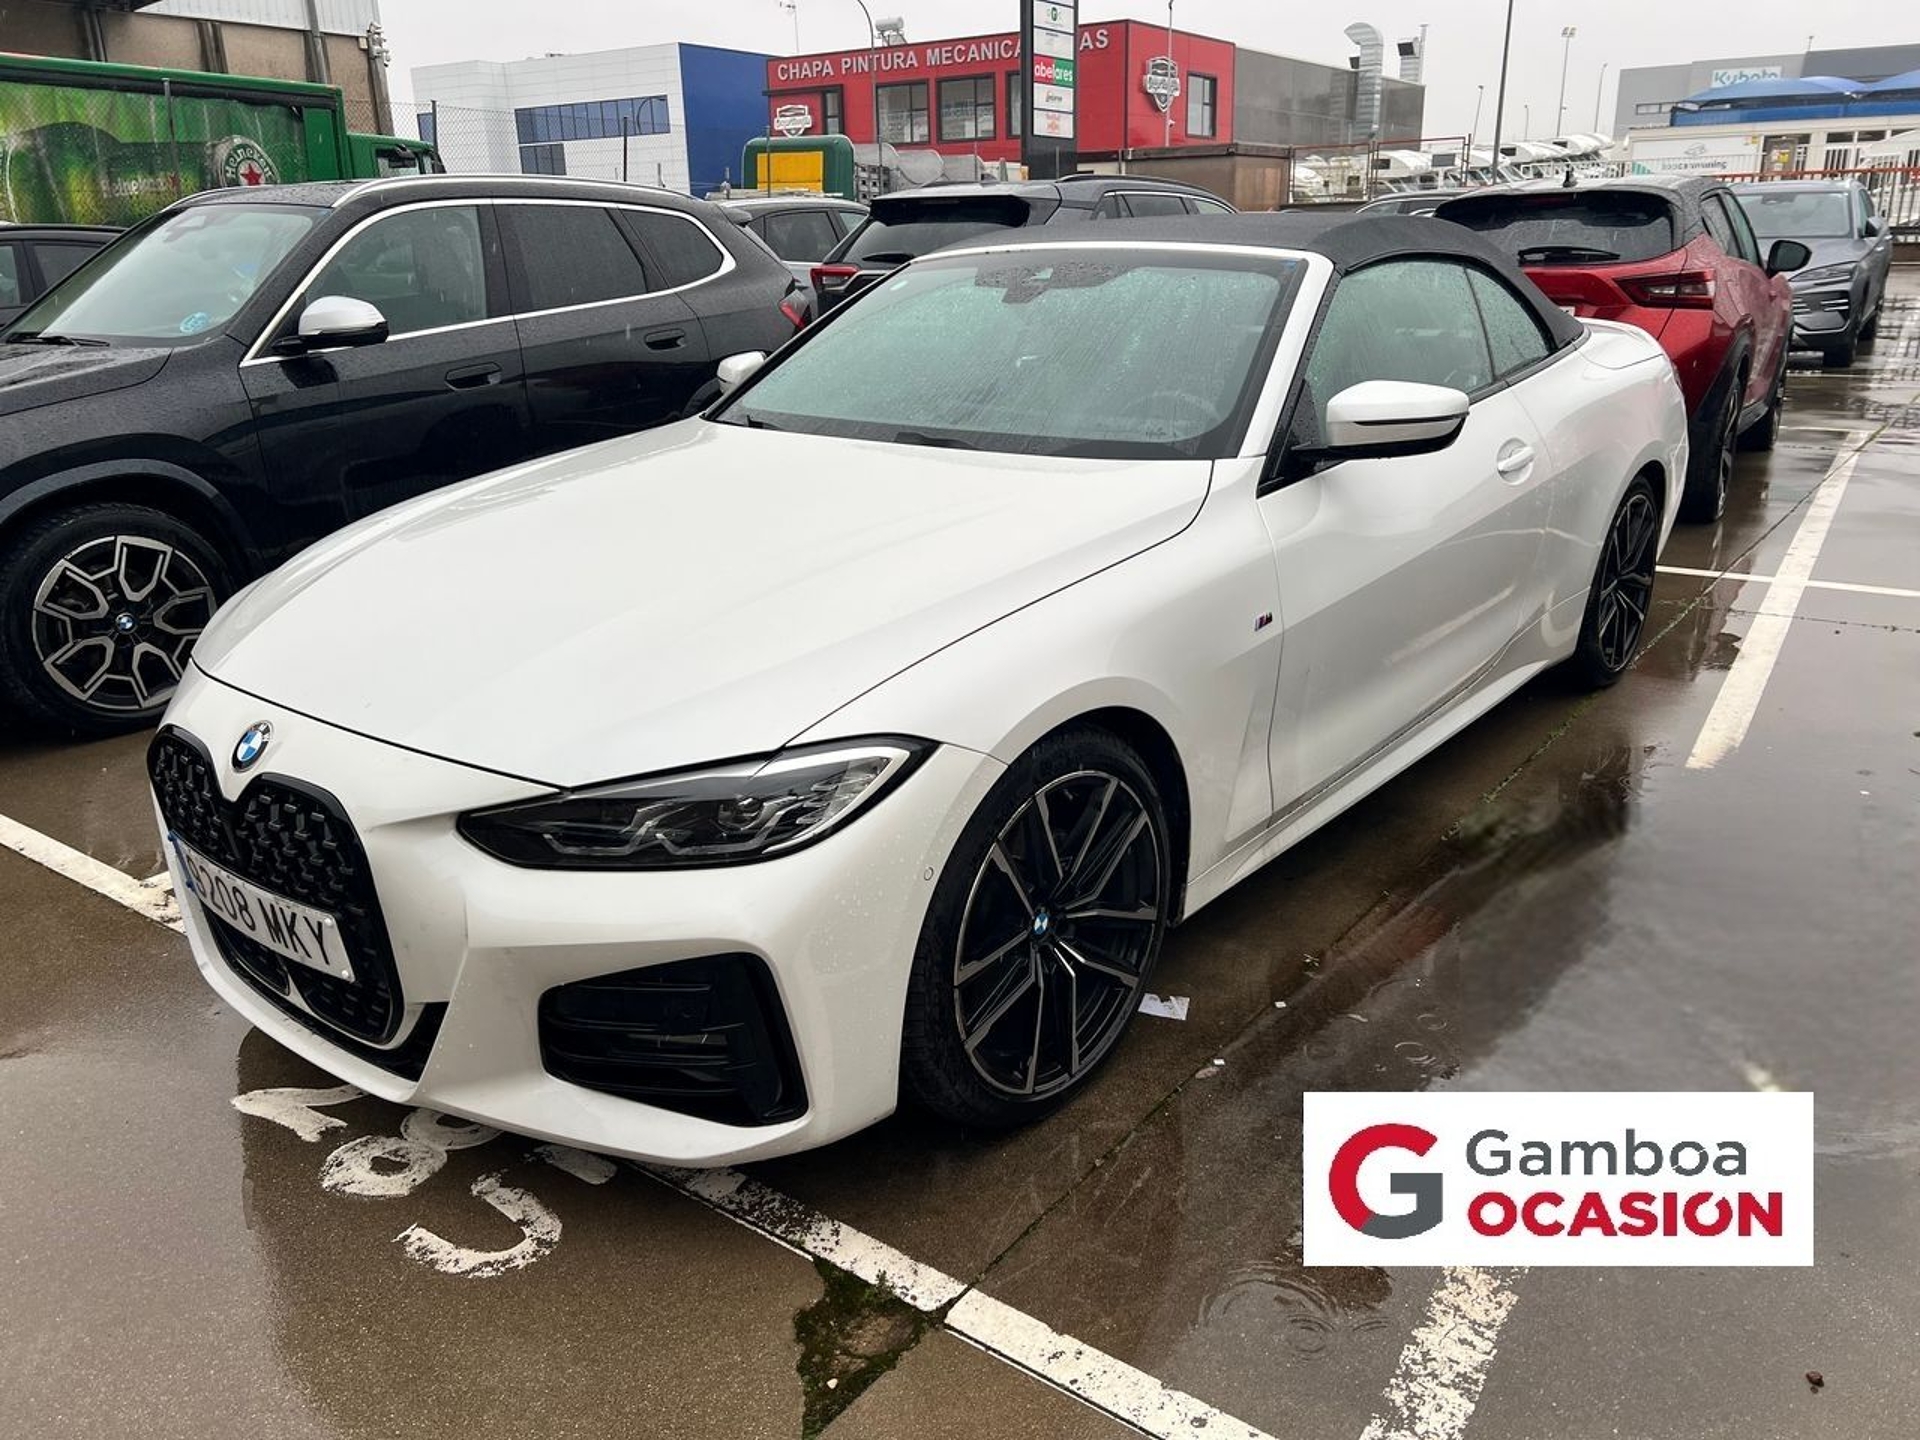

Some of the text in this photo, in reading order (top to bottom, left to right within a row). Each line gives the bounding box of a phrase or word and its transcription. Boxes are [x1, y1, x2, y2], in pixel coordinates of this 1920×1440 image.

[778, 60, 834, 80] CHAPA
[841, 51, 918, 75] PINTURA
[186, 854, 330, 966] 9208 MKY
